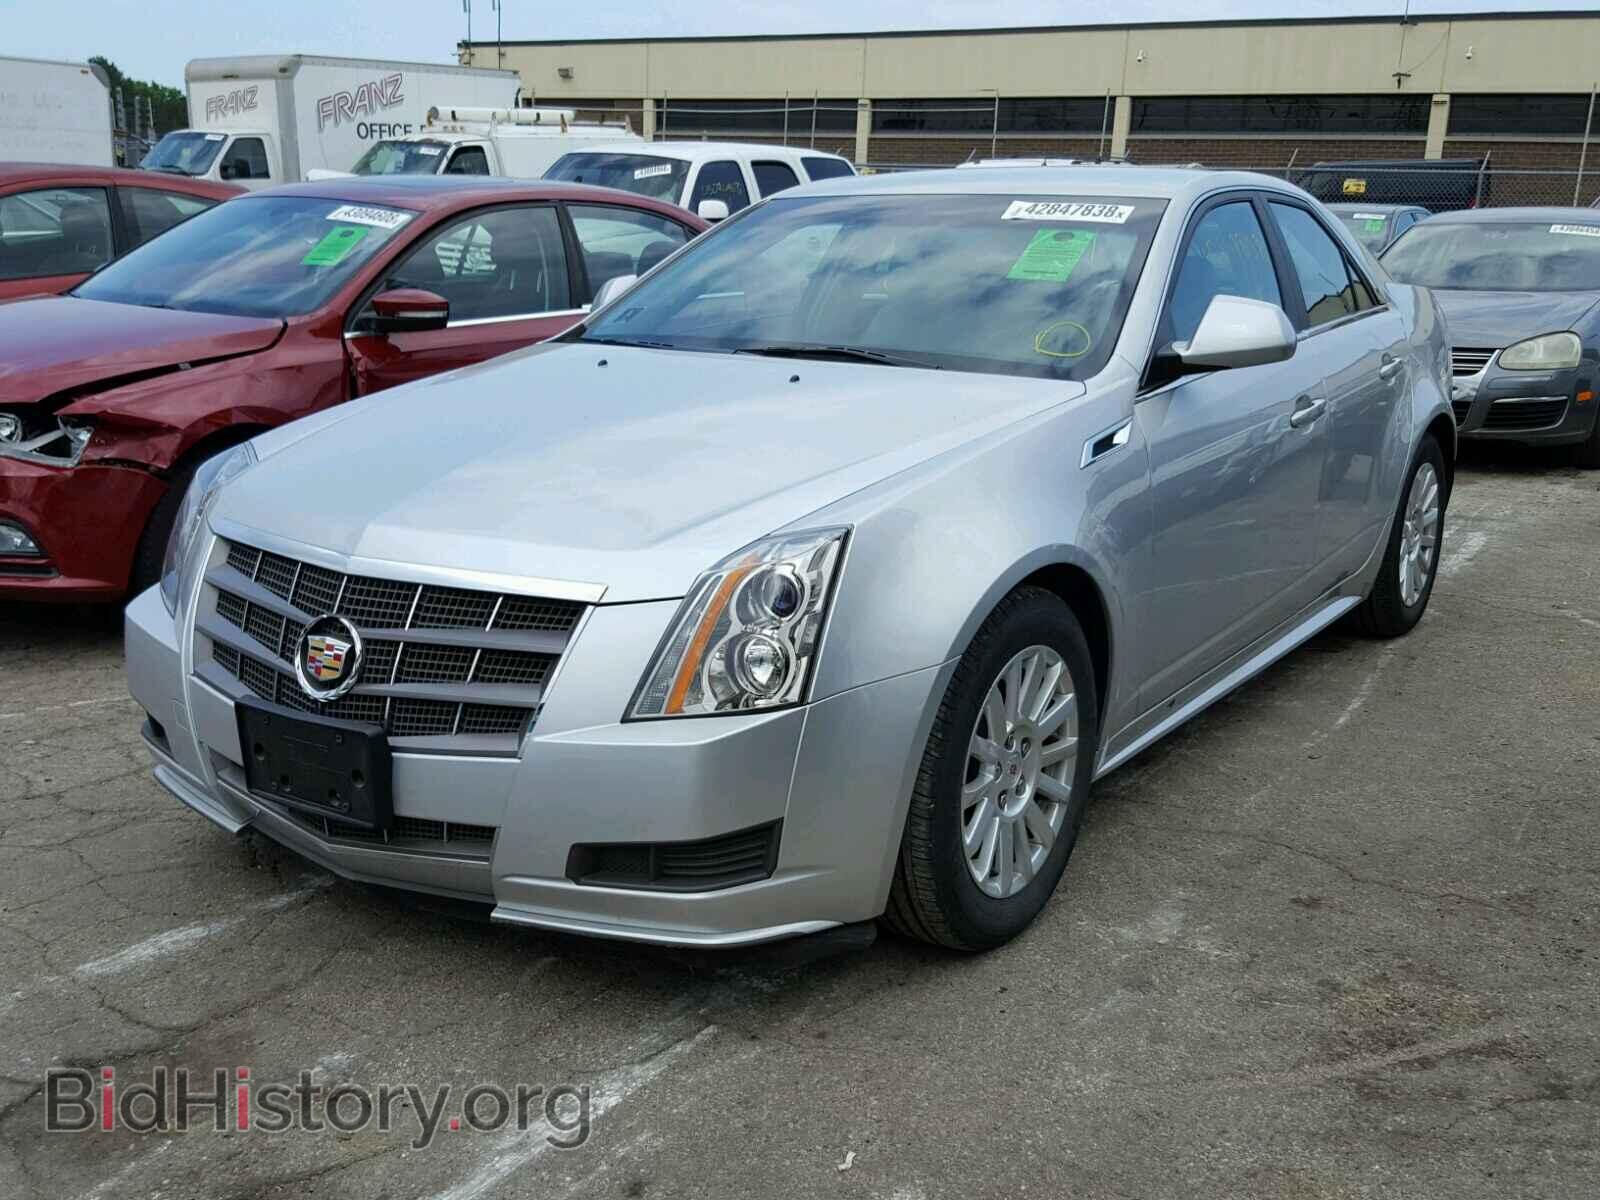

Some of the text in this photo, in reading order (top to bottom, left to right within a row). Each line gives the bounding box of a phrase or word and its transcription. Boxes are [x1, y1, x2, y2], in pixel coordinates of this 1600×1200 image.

[206, 85, 259, 122] FRANZ
[317, 73, 405, 131] FRANZ
[357, 121, 412, 139] OFFICE
